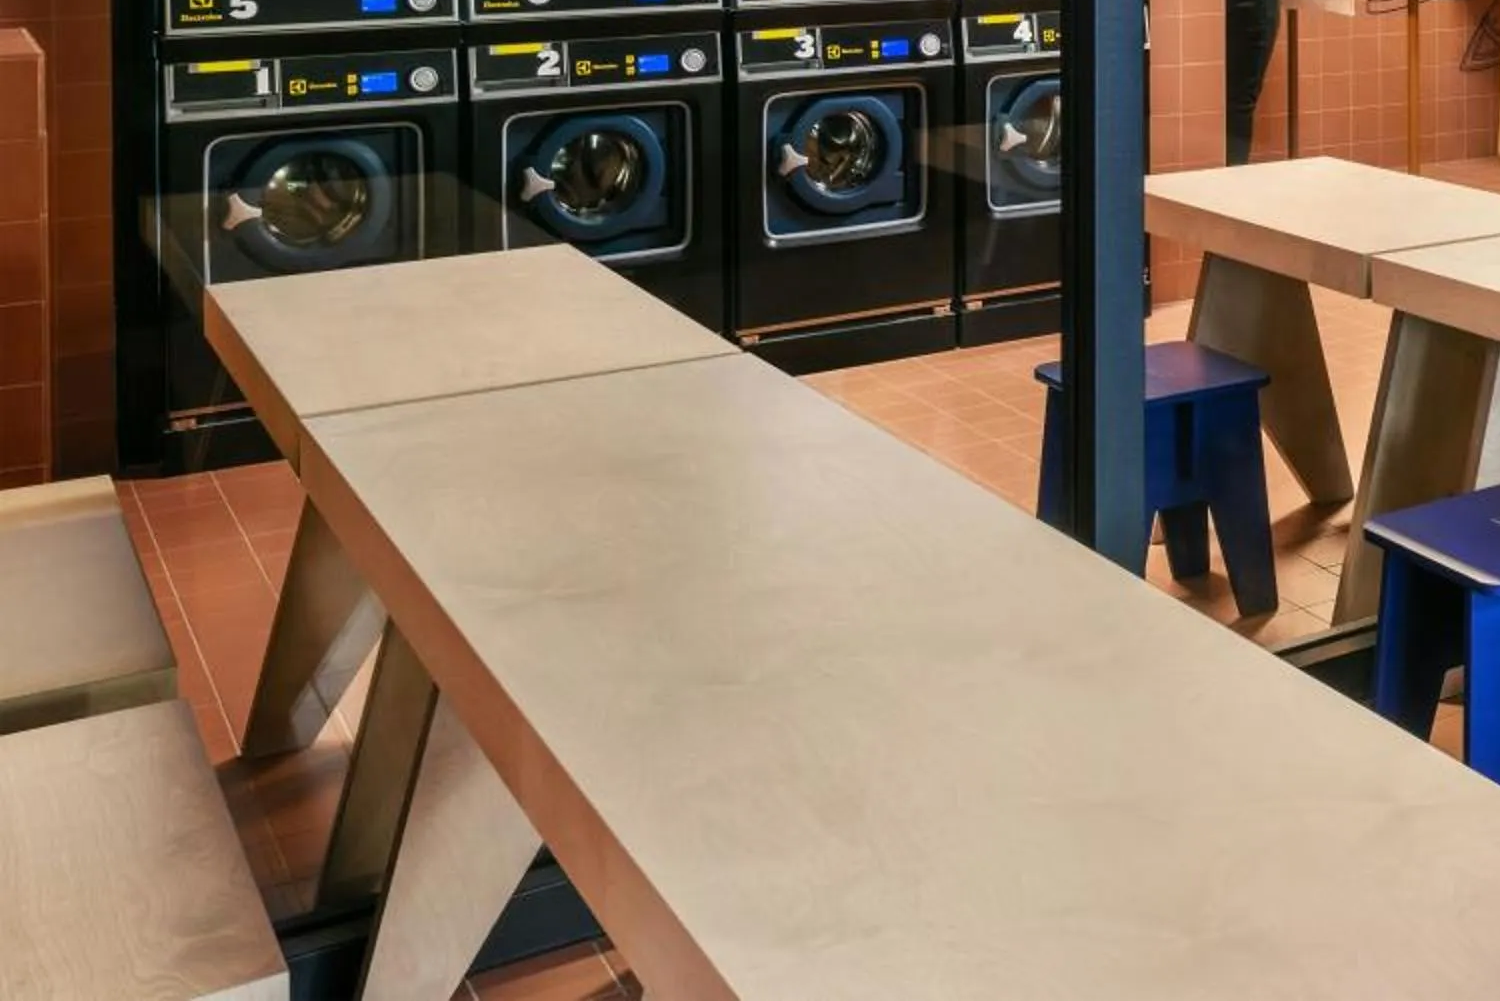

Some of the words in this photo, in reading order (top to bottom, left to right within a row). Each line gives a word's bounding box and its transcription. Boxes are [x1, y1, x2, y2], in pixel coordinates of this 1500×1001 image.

[1012, 19, 1033, 44] 4
[793, 33, 815, 60] 3
[536, 49, 562, 77] 2
[255, 66, 272, 96] 1
